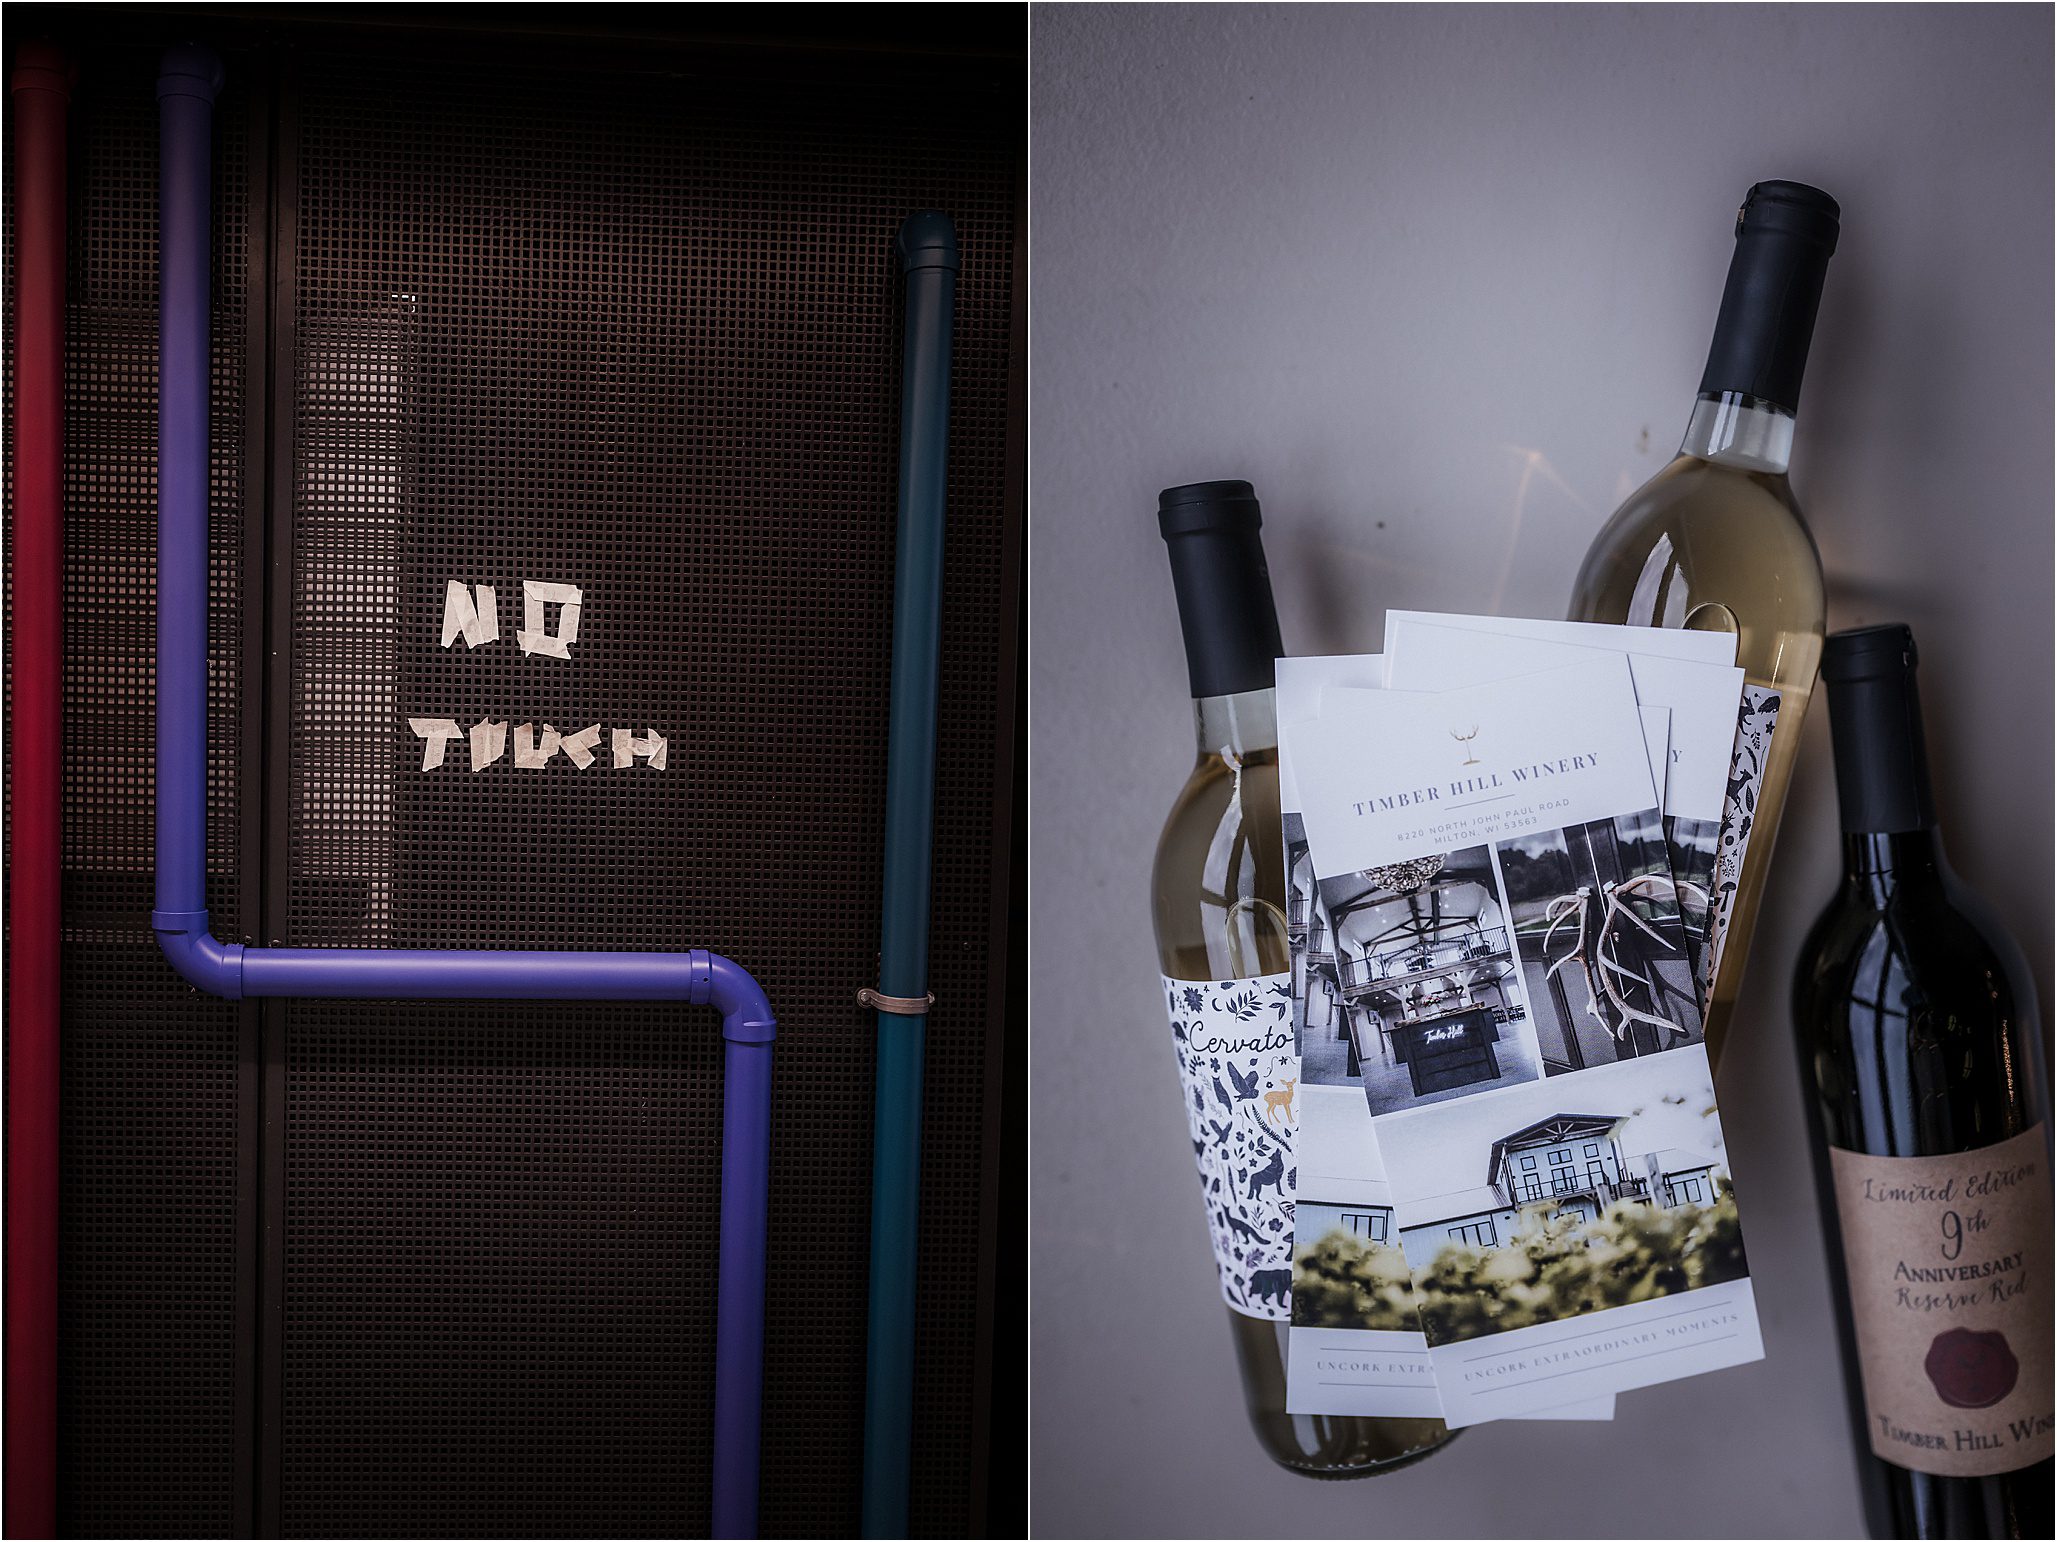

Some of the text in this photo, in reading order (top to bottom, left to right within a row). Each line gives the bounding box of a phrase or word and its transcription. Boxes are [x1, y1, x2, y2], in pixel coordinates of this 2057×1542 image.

[1352, 752, 1599, 816] TIMBER HILL WINERY
[1397, 798, 1570, 841] 8220 NORTH JOHN PAUL ROAD
[1434, 816, 1537, 844] MILTON, WI 53563
[1864, 1162, 2035, 1202] Limited Edition
[1895, 1272, 2028, 1312] Reserve Red
[1316, 1361, 1380, 1373] UNCORK
[1464, 1313, 1739, 1382] UNCORK EXTRAORDINARY MOMENTS
